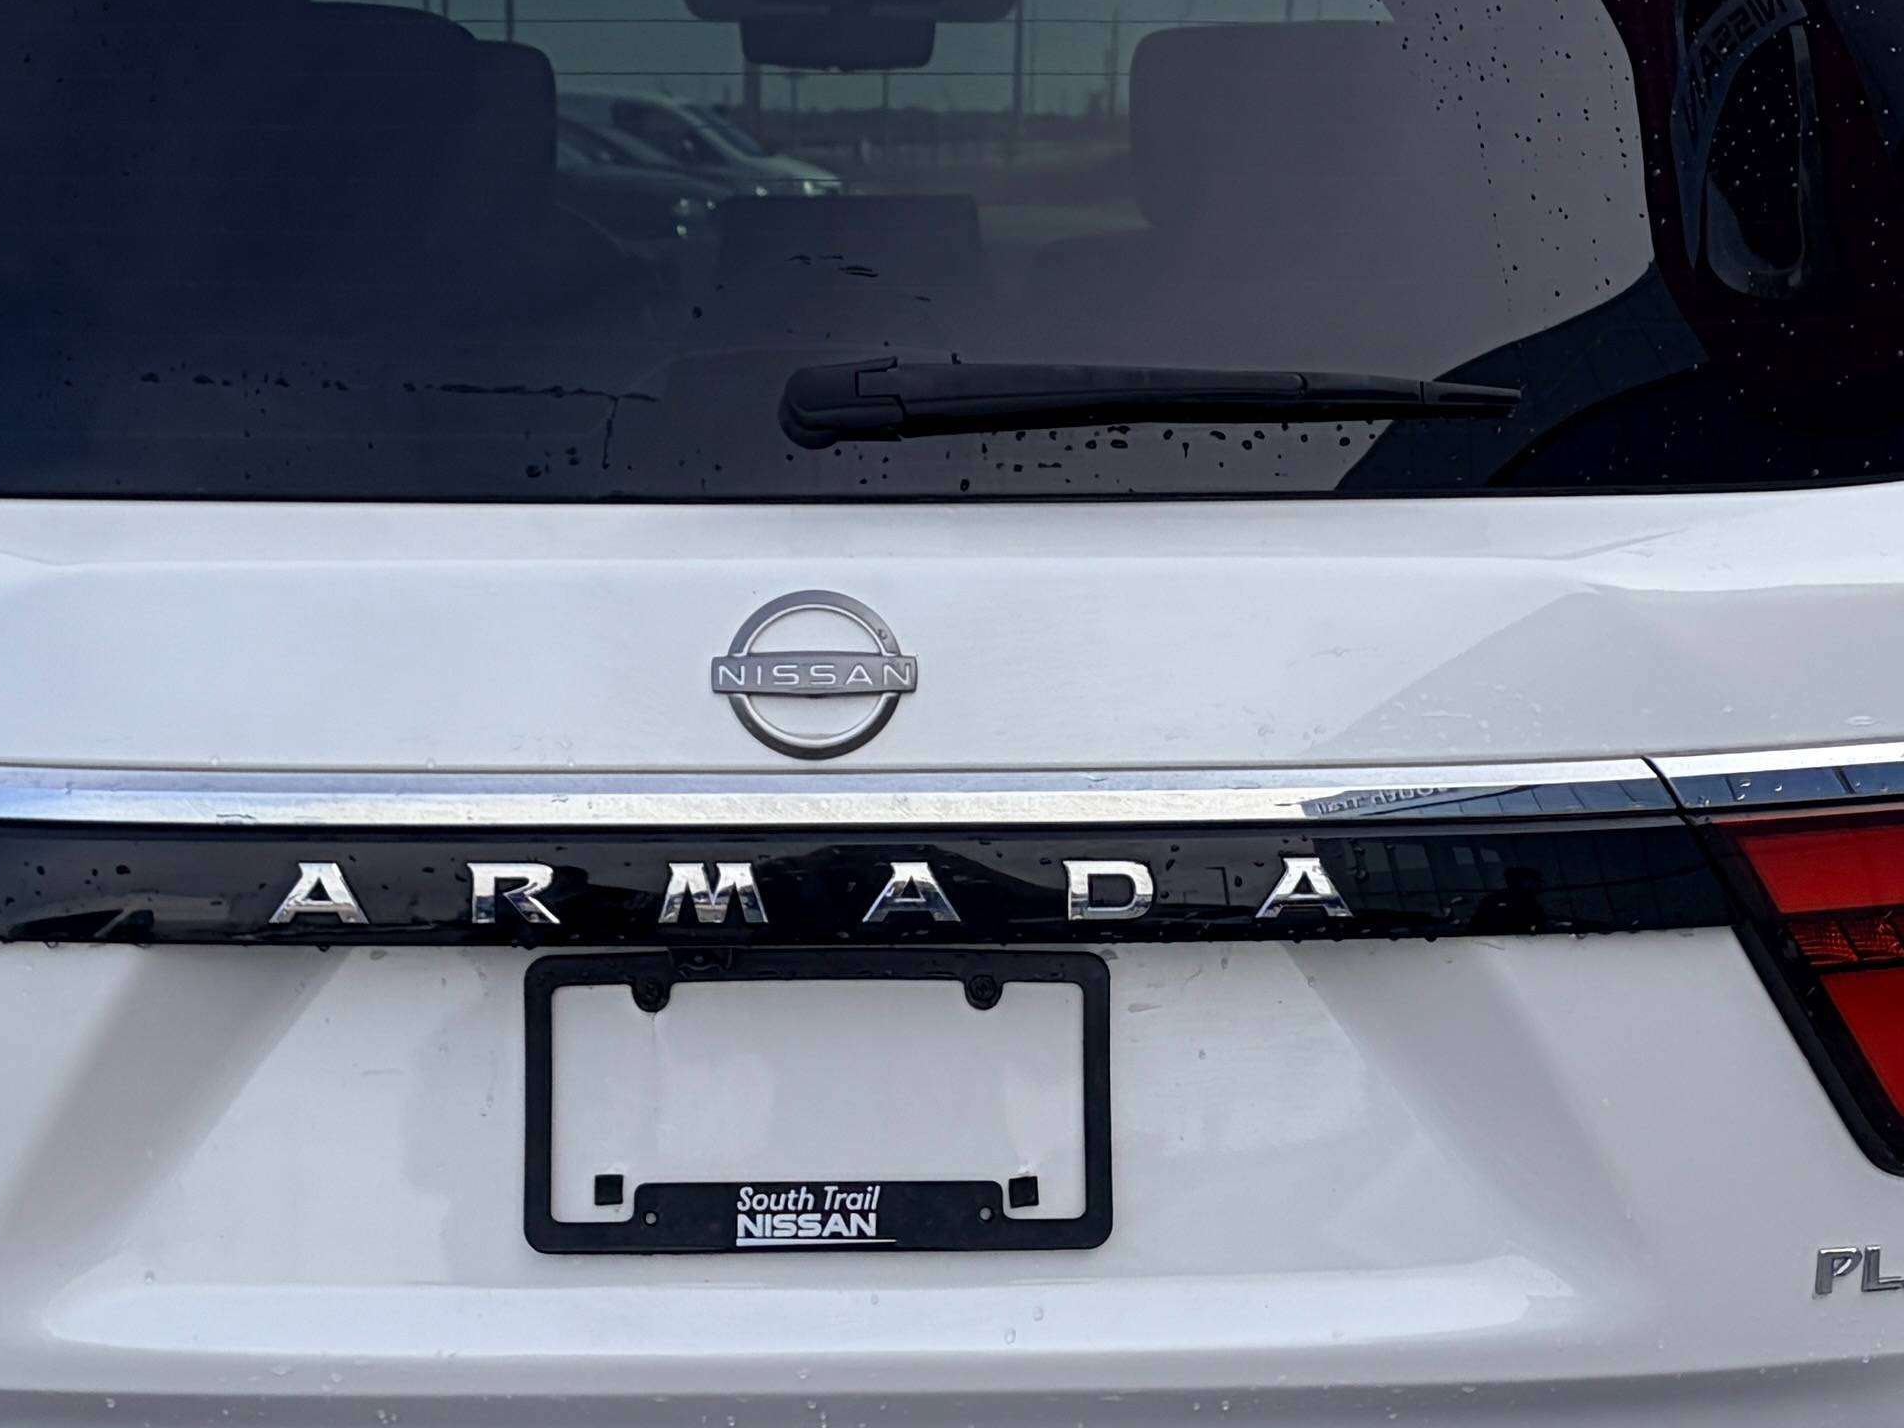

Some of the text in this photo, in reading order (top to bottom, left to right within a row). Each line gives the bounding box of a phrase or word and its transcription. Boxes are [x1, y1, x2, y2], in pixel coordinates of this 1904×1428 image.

[718, 663, 911, 686] NISSAN
[268, 857, 1354, 925] ARMADA
[736, 1185, 881, 1211] South Trail
[737, 1212, 877, 1238] NISSAN
